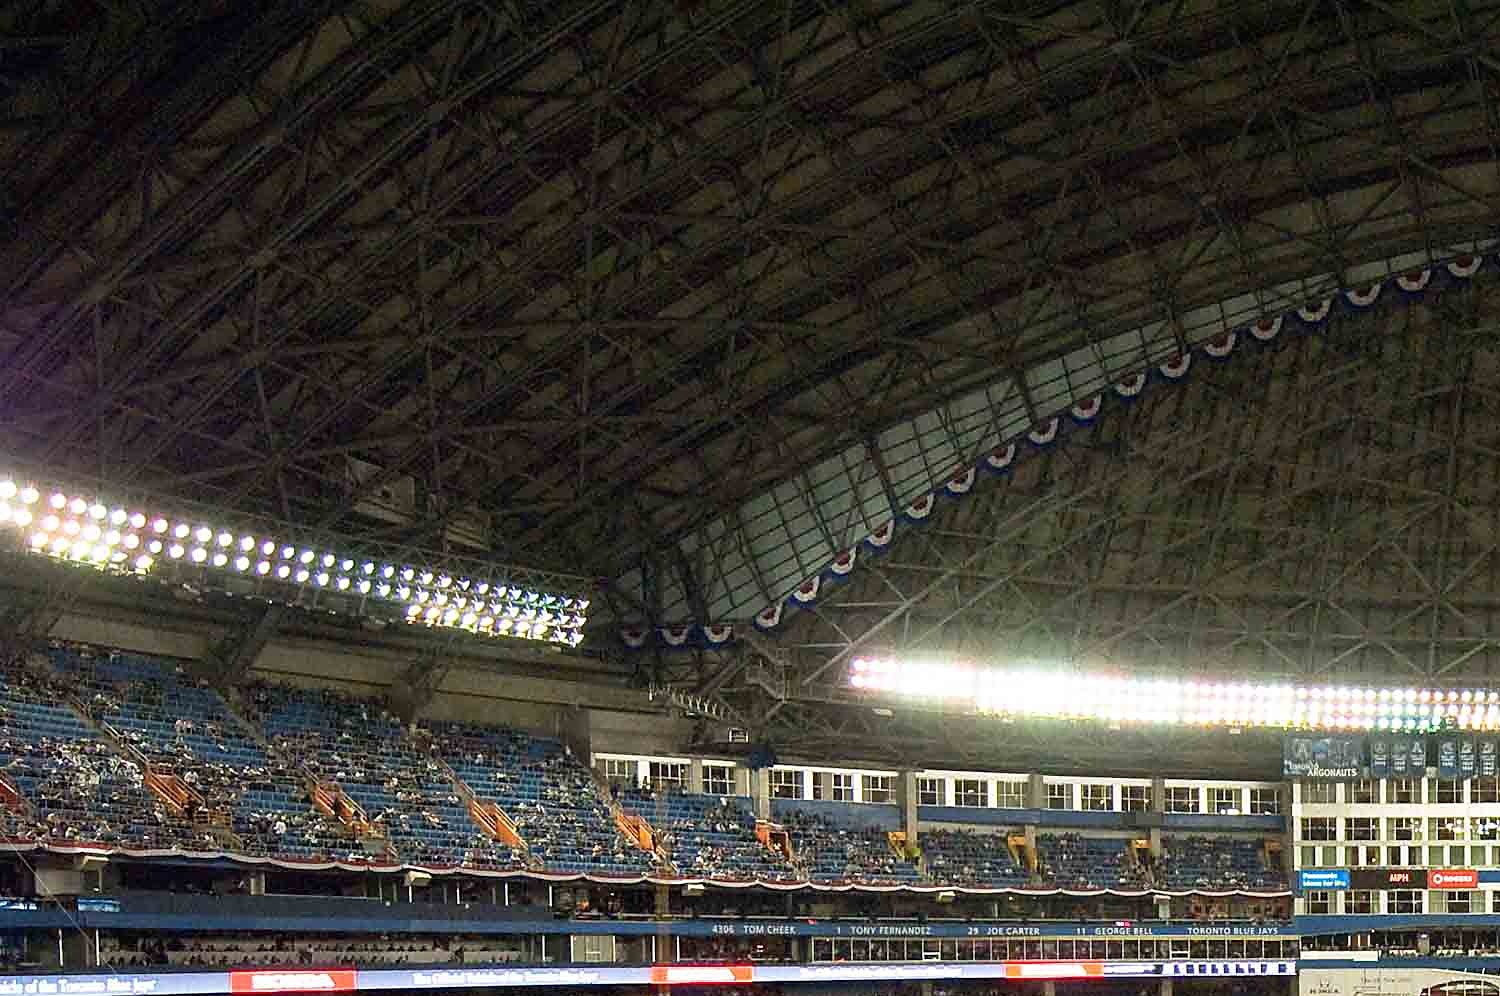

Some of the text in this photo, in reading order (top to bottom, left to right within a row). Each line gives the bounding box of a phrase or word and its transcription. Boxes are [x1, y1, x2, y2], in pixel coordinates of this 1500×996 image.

[1307, 768, 1358, 777] ARGONAUTS
[1389, 873, 1409, 882] MPH
[744, 925, 764, 934] TOM
[767, 925, 797, 934] CHEEK
[851, 925, 875, 935] TONY
[879, 925, 933, 935] FERNANDEZ
[987, 927, 1004, 935] JOE
[1006, 927, 1040, 935] CARTER
[1095, 927, 1130, 936] GEORGE
[1133, 927, 1153, 935] BELL
[1188, 927, 1278, 936] TORONTO BLUE JAYS
